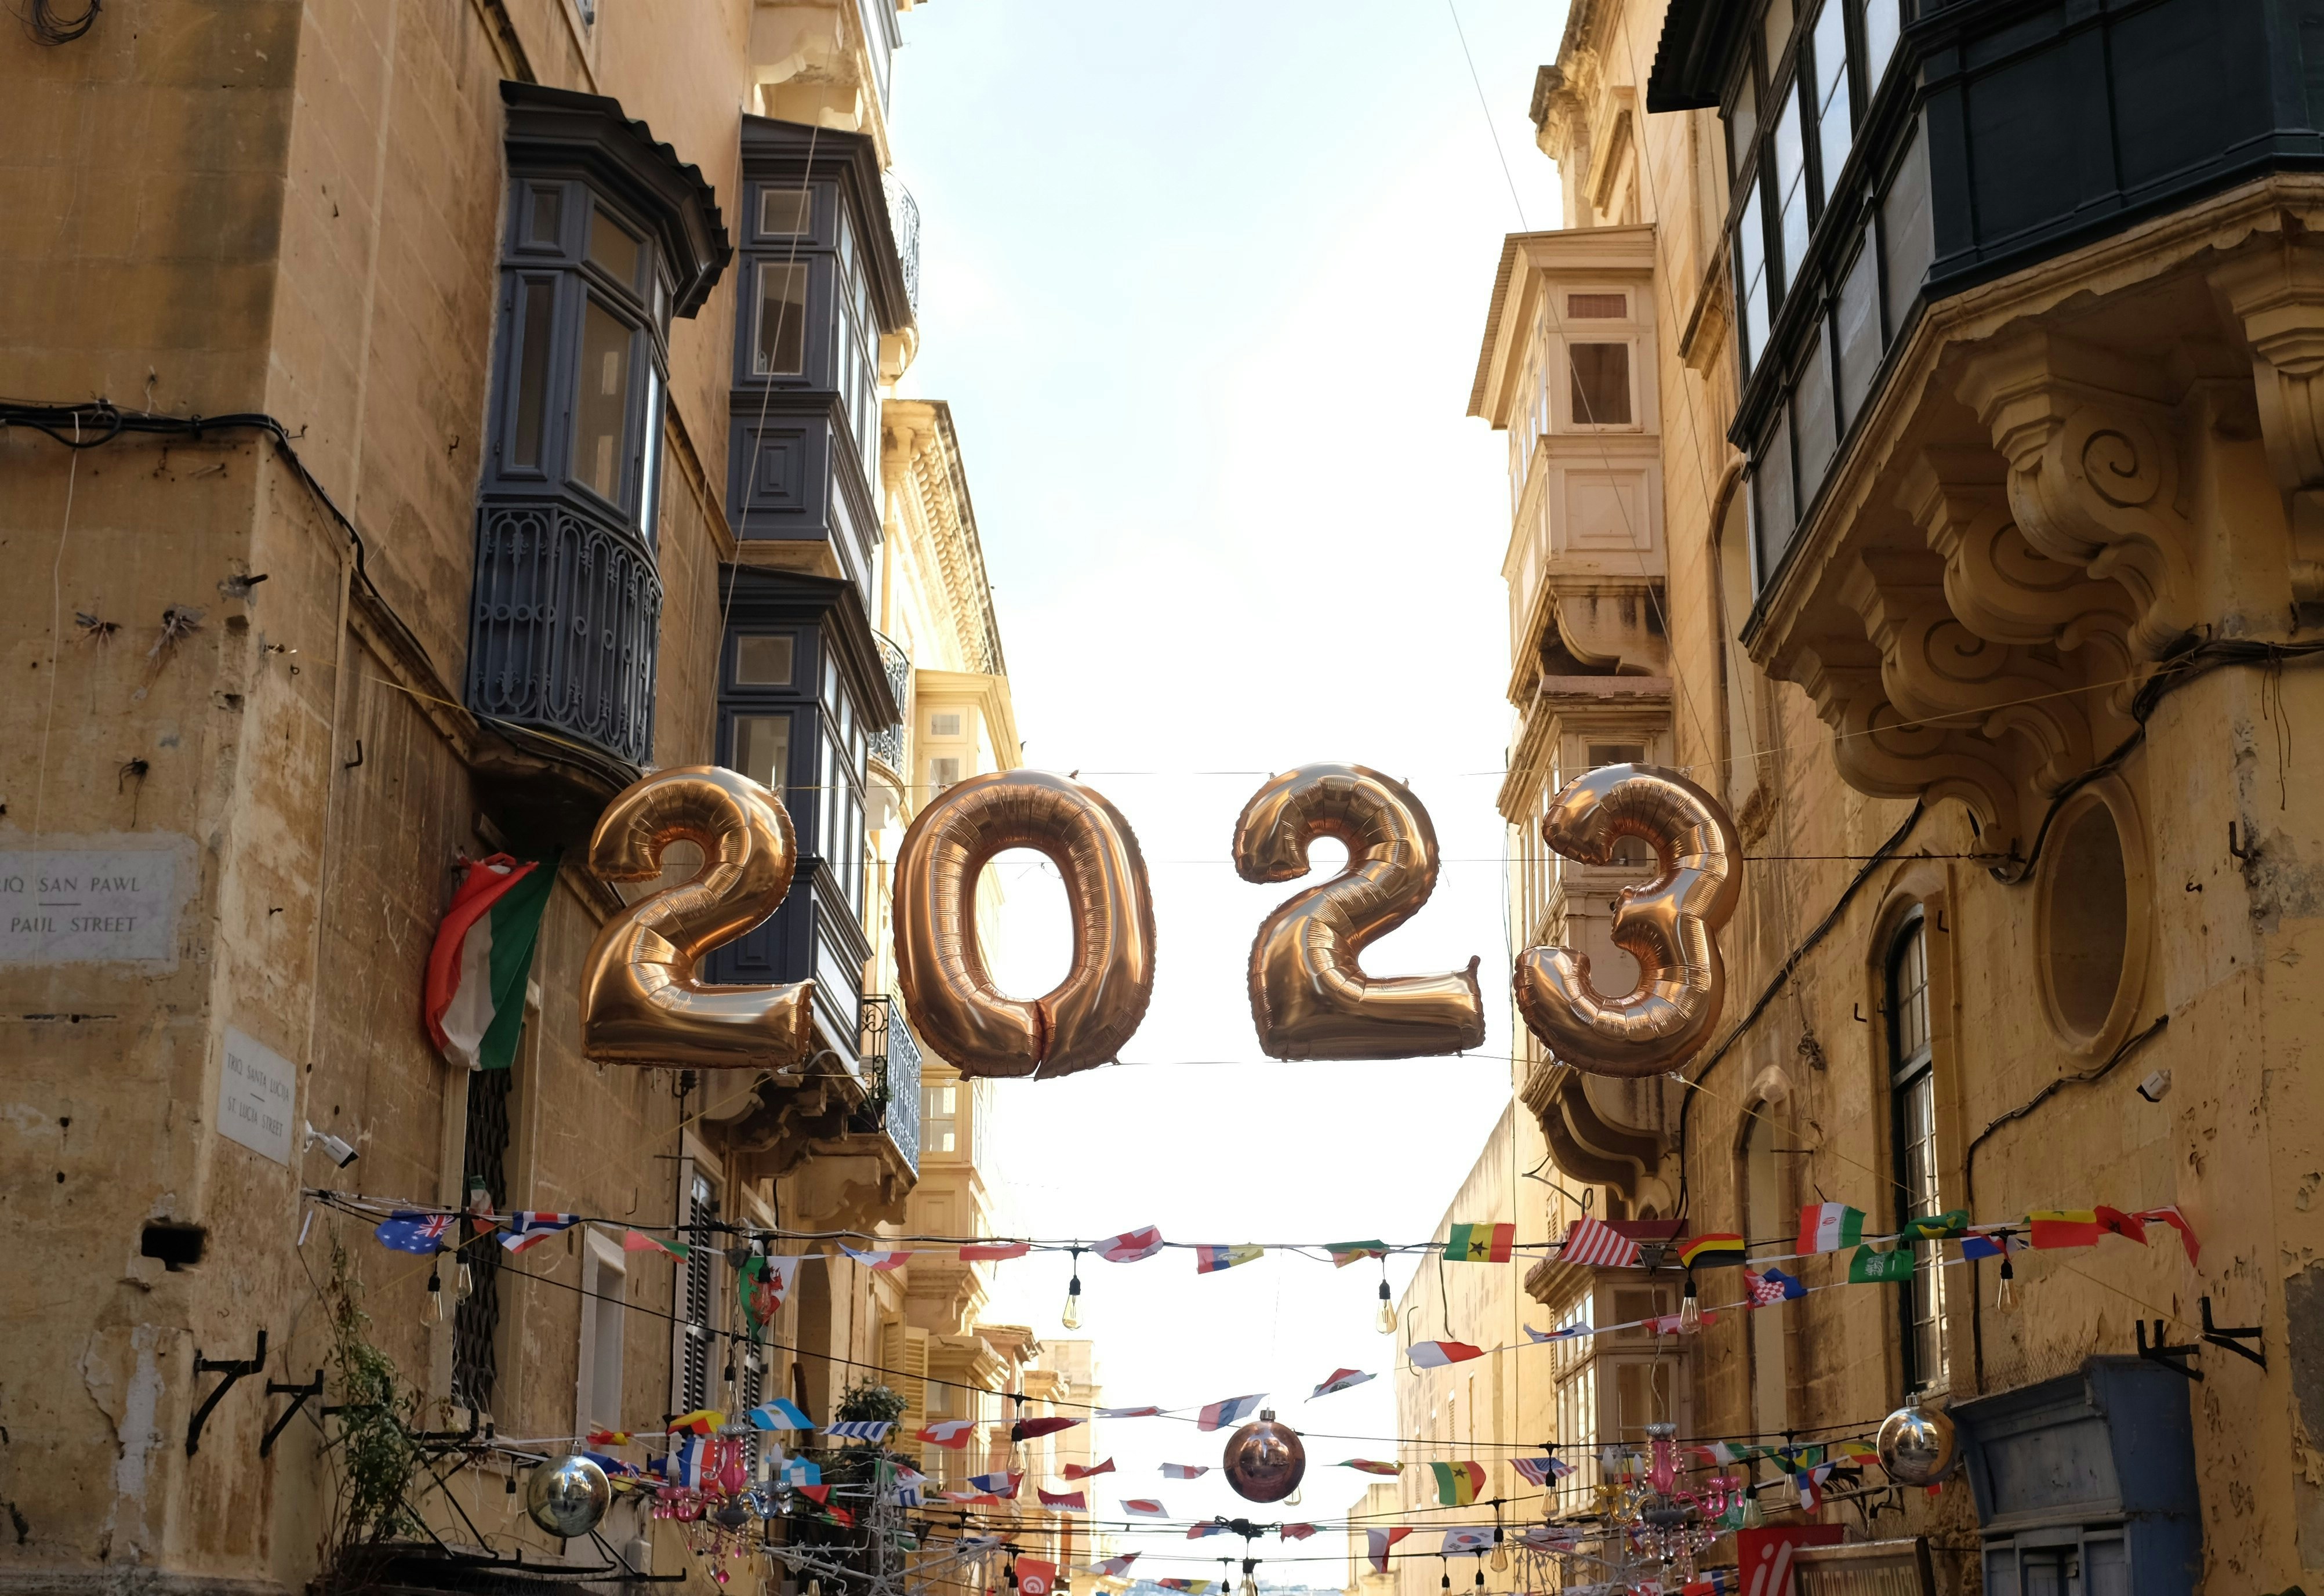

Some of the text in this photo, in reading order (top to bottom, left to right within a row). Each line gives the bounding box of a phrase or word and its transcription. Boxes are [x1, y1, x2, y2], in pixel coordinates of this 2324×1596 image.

[0, 876, 140, 893] IQ SAN PAWL
[10, 917, 137, 933] PAUL STREET
[228, 1053, 242, 1075] TRIQ
[246, 1065, 267, 1089] SANTA
[239, 1102, 257, 1125] LUCIA
[262, 1114, 284, 1137] STREET
